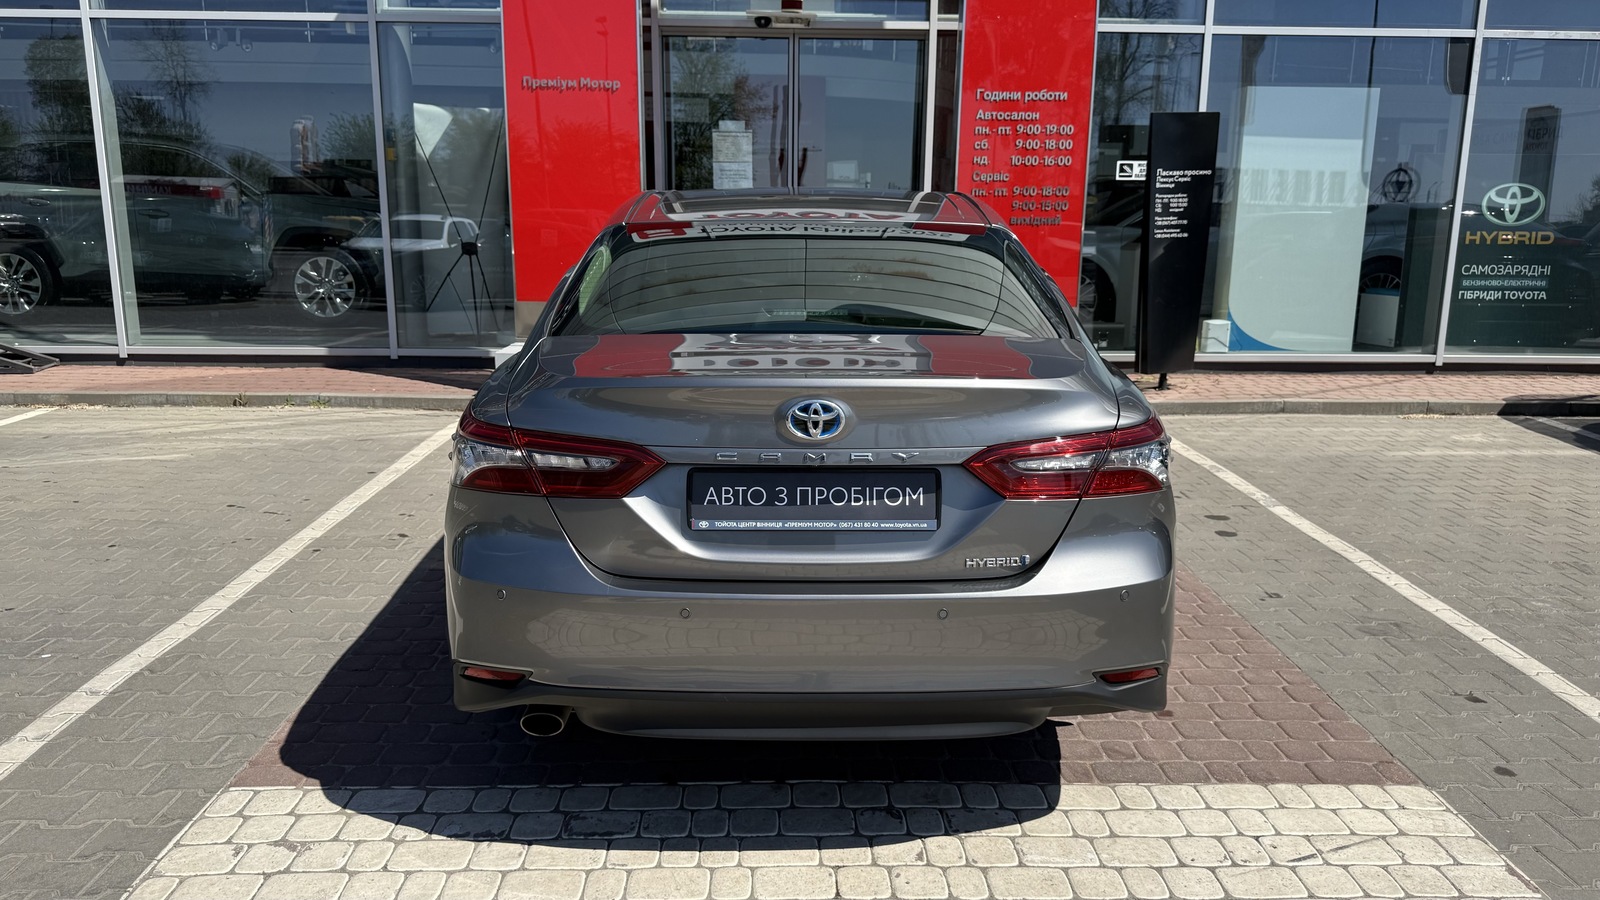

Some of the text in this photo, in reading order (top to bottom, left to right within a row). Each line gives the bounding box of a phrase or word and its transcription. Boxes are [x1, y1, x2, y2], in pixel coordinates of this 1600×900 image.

[522, 76, 621, 91] Преміум Мотор
[976, 88, 1068, 103] Години роботи
[976, 109, 1040, 121] Автосалон
[1015, 124, 1074, 136] 9:00-19:00
[1015, 139, 1073, 151] 9:00-18:00
[1010, 155, 1072, 167] 10:00-16:00
[972, 171, 1010, 183] Сервіс
[1012, 186, 1070, 197] 9:00-18:00
[1010, 215, 1062, 226] вихідний
[1464, 231, 1555, 245] HYBRID
[1461, 264, 1551, 276] САМОЗАРЯДНІ
[1462, 279, 1546, 287] БЕНЗИНОВО-ЕЛЕКТРИЧНІ
[1458, 290, 1547, 300] ГІБРИДИ TOYOTA
[716, 452, 920, 463] CAMRY
[703, 486, 924, 506] АВТО З ПРОБІГОМ
[715, 520, 738, 528] ТОЙОТА
[838, 521, 853, 529] (067)
[965, 556, 1020, 569] HYBRID
